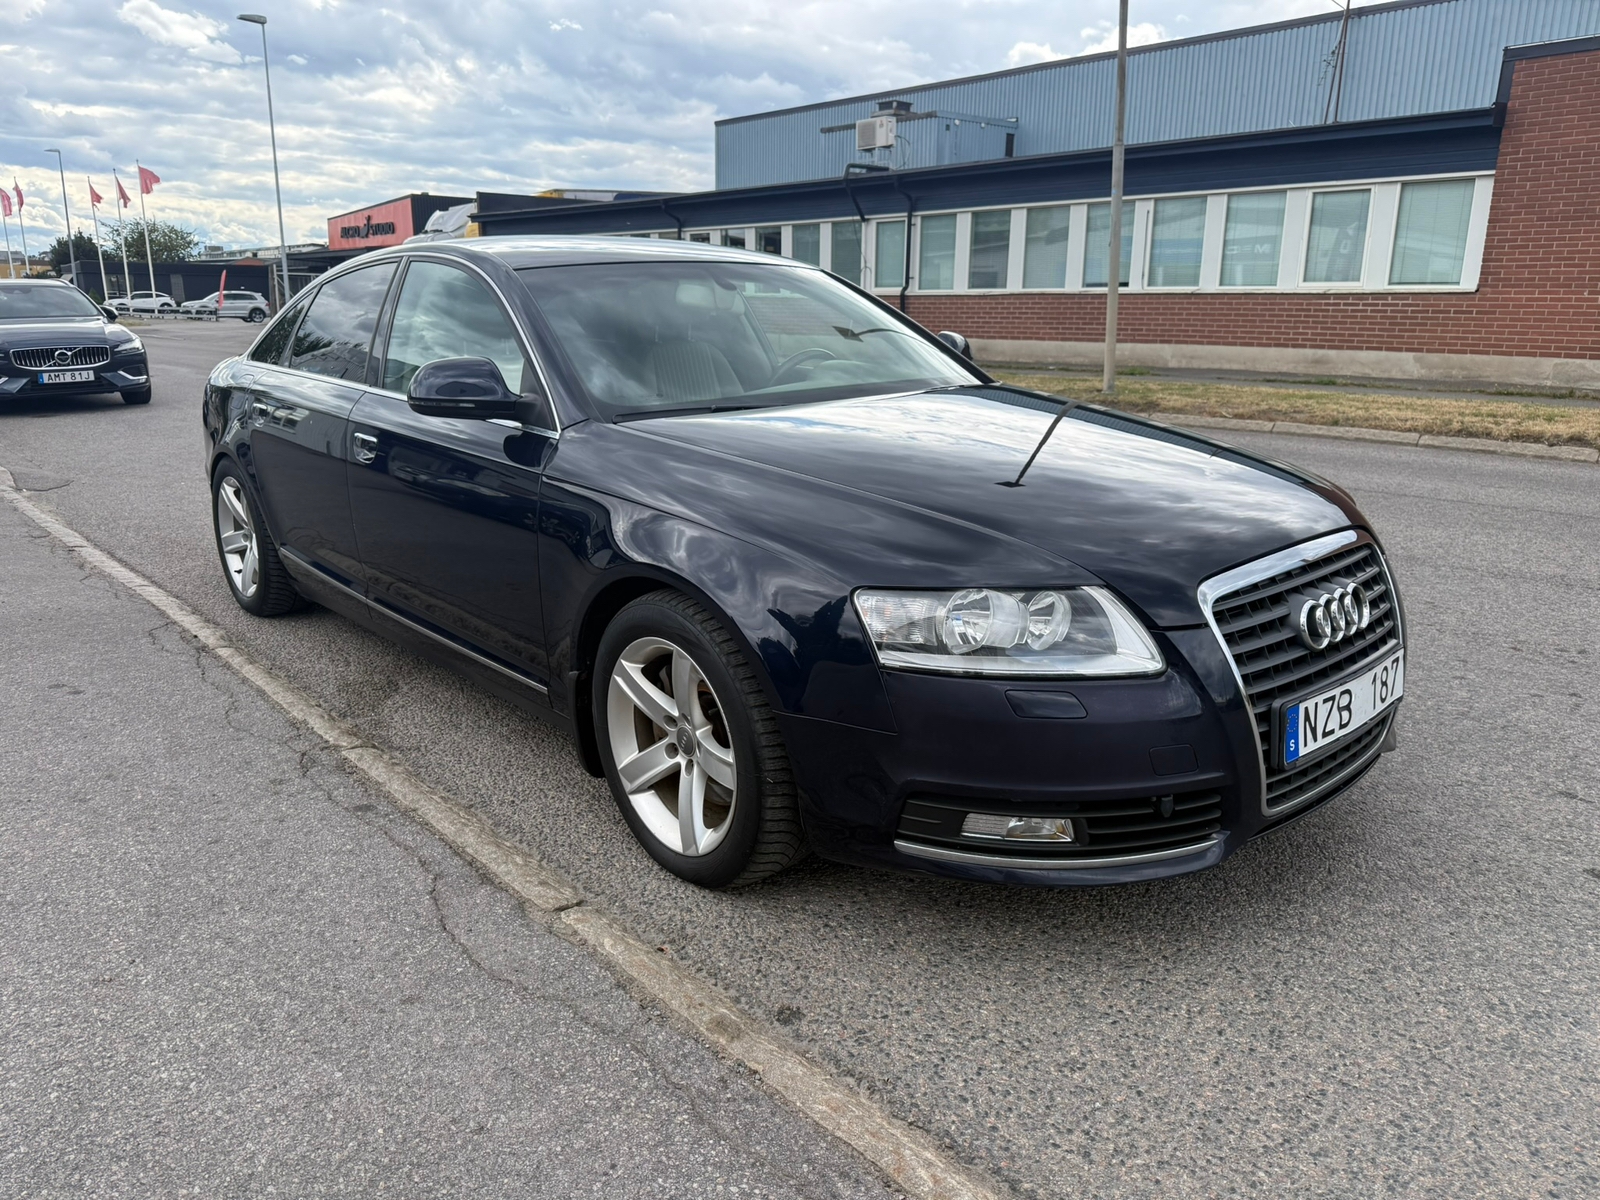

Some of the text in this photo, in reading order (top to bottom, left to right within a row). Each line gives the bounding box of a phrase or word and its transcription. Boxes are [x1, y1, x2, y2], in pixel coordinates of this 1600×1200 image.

[370, 222, 395, 236] STUDIO
[47, 371, 91, 382] AMT 81J
[1303, 655, 1400, 748] NZB 187
[1289, 739, 1295, 751] S
